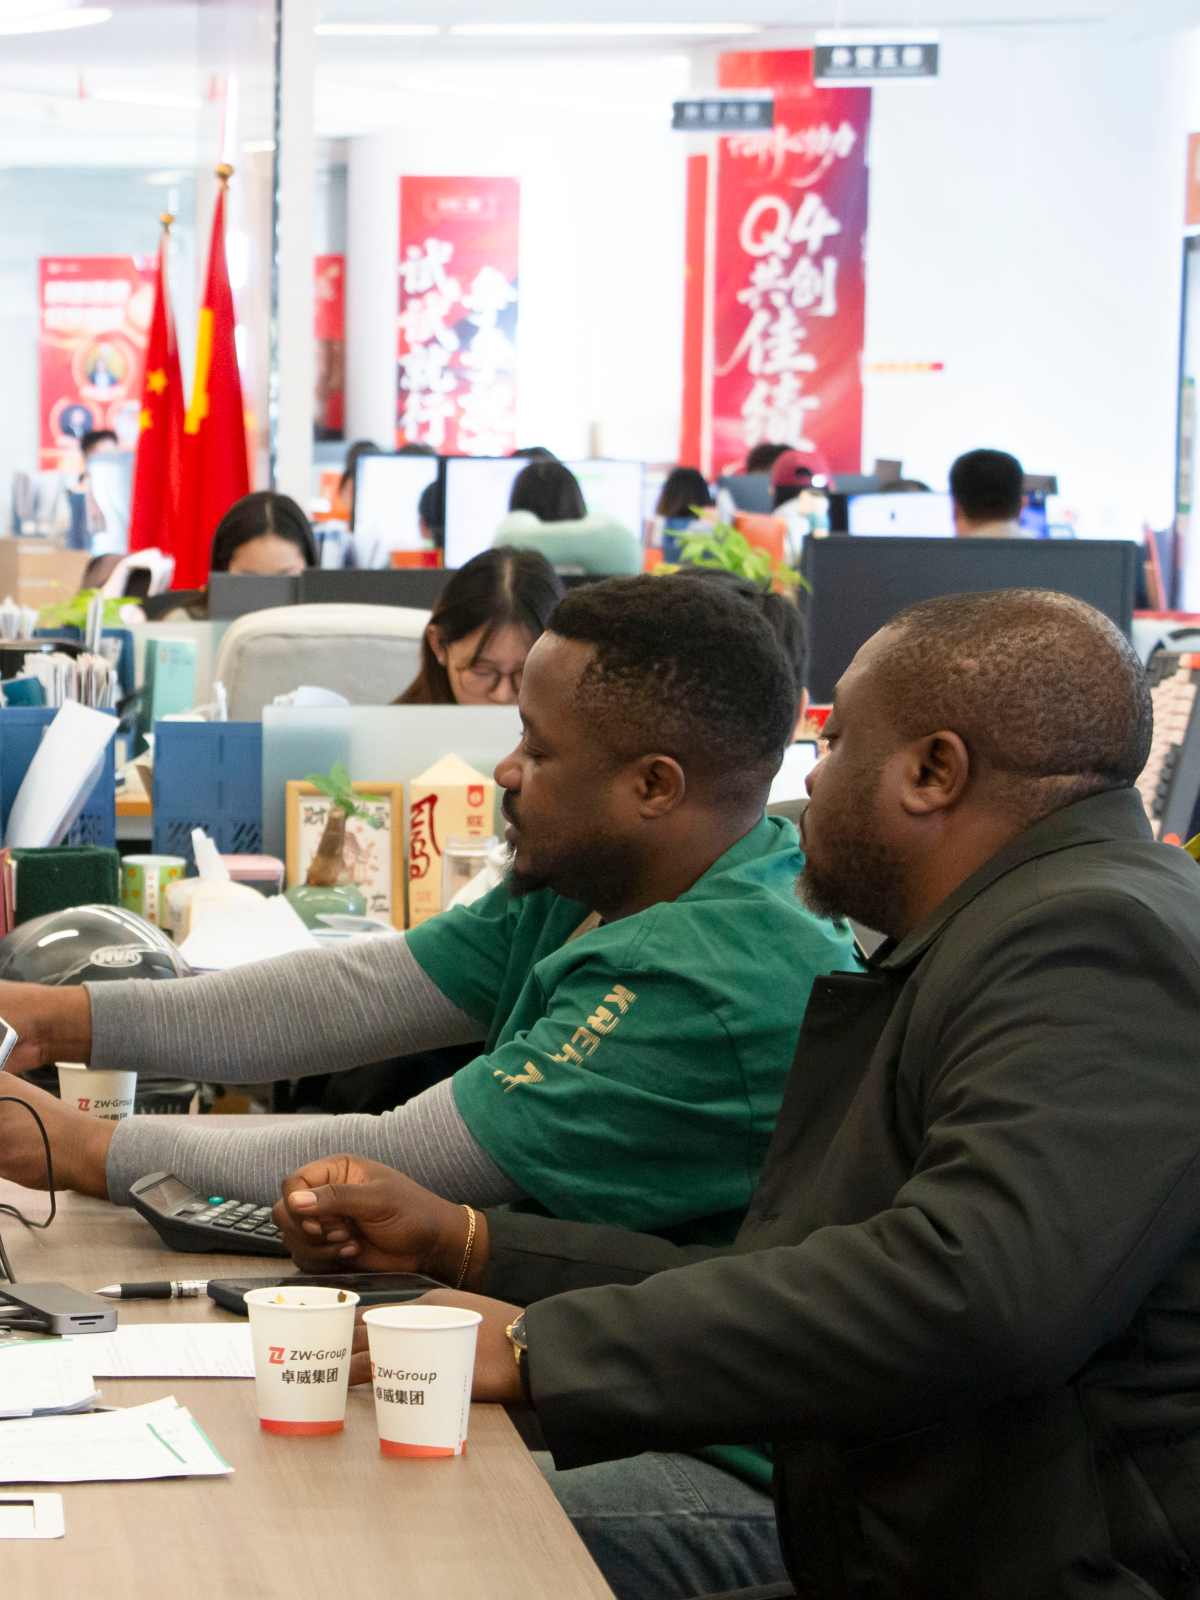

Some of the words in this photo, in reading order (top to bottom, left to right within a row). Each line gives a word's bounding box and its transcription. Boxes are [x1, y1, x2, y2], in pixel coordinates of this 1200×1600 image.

[739, 192, 841, 259] Q4
[737, 255, 837, 317] 共创
[289, 1347, 347, 1362] ZW-Group
[281, 1367, 339, 1384] 卓威集团
[377, 1366, 438, 1385] ZW-Group
